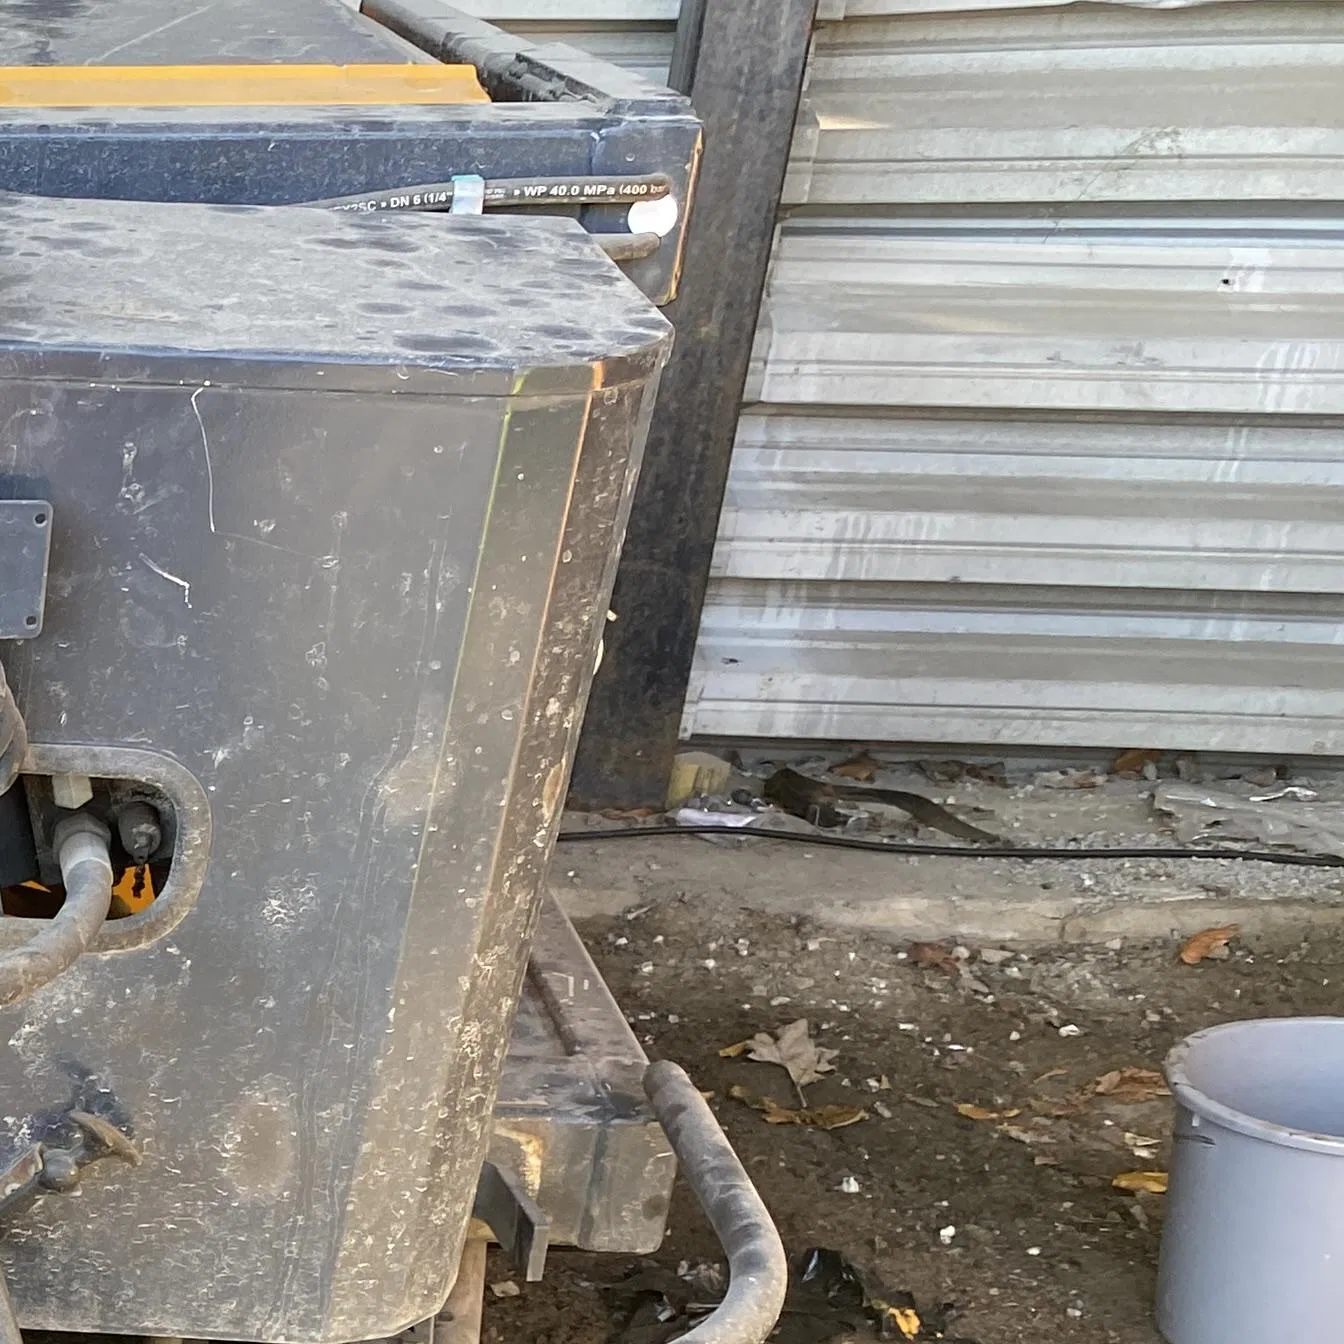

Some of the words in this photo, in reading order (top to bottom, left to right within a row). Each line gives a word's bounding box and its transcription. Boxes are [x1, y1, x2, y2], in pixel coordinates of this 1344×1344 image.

[390, 195, 410, 208] DN
[413, 194, 421, 205] 6
[523, 185, 547, 196] WP
[549, 184, 579, 196] 40.0
[583, 184, 615, 196] MPa
[619, 184, 647, 195] (400
